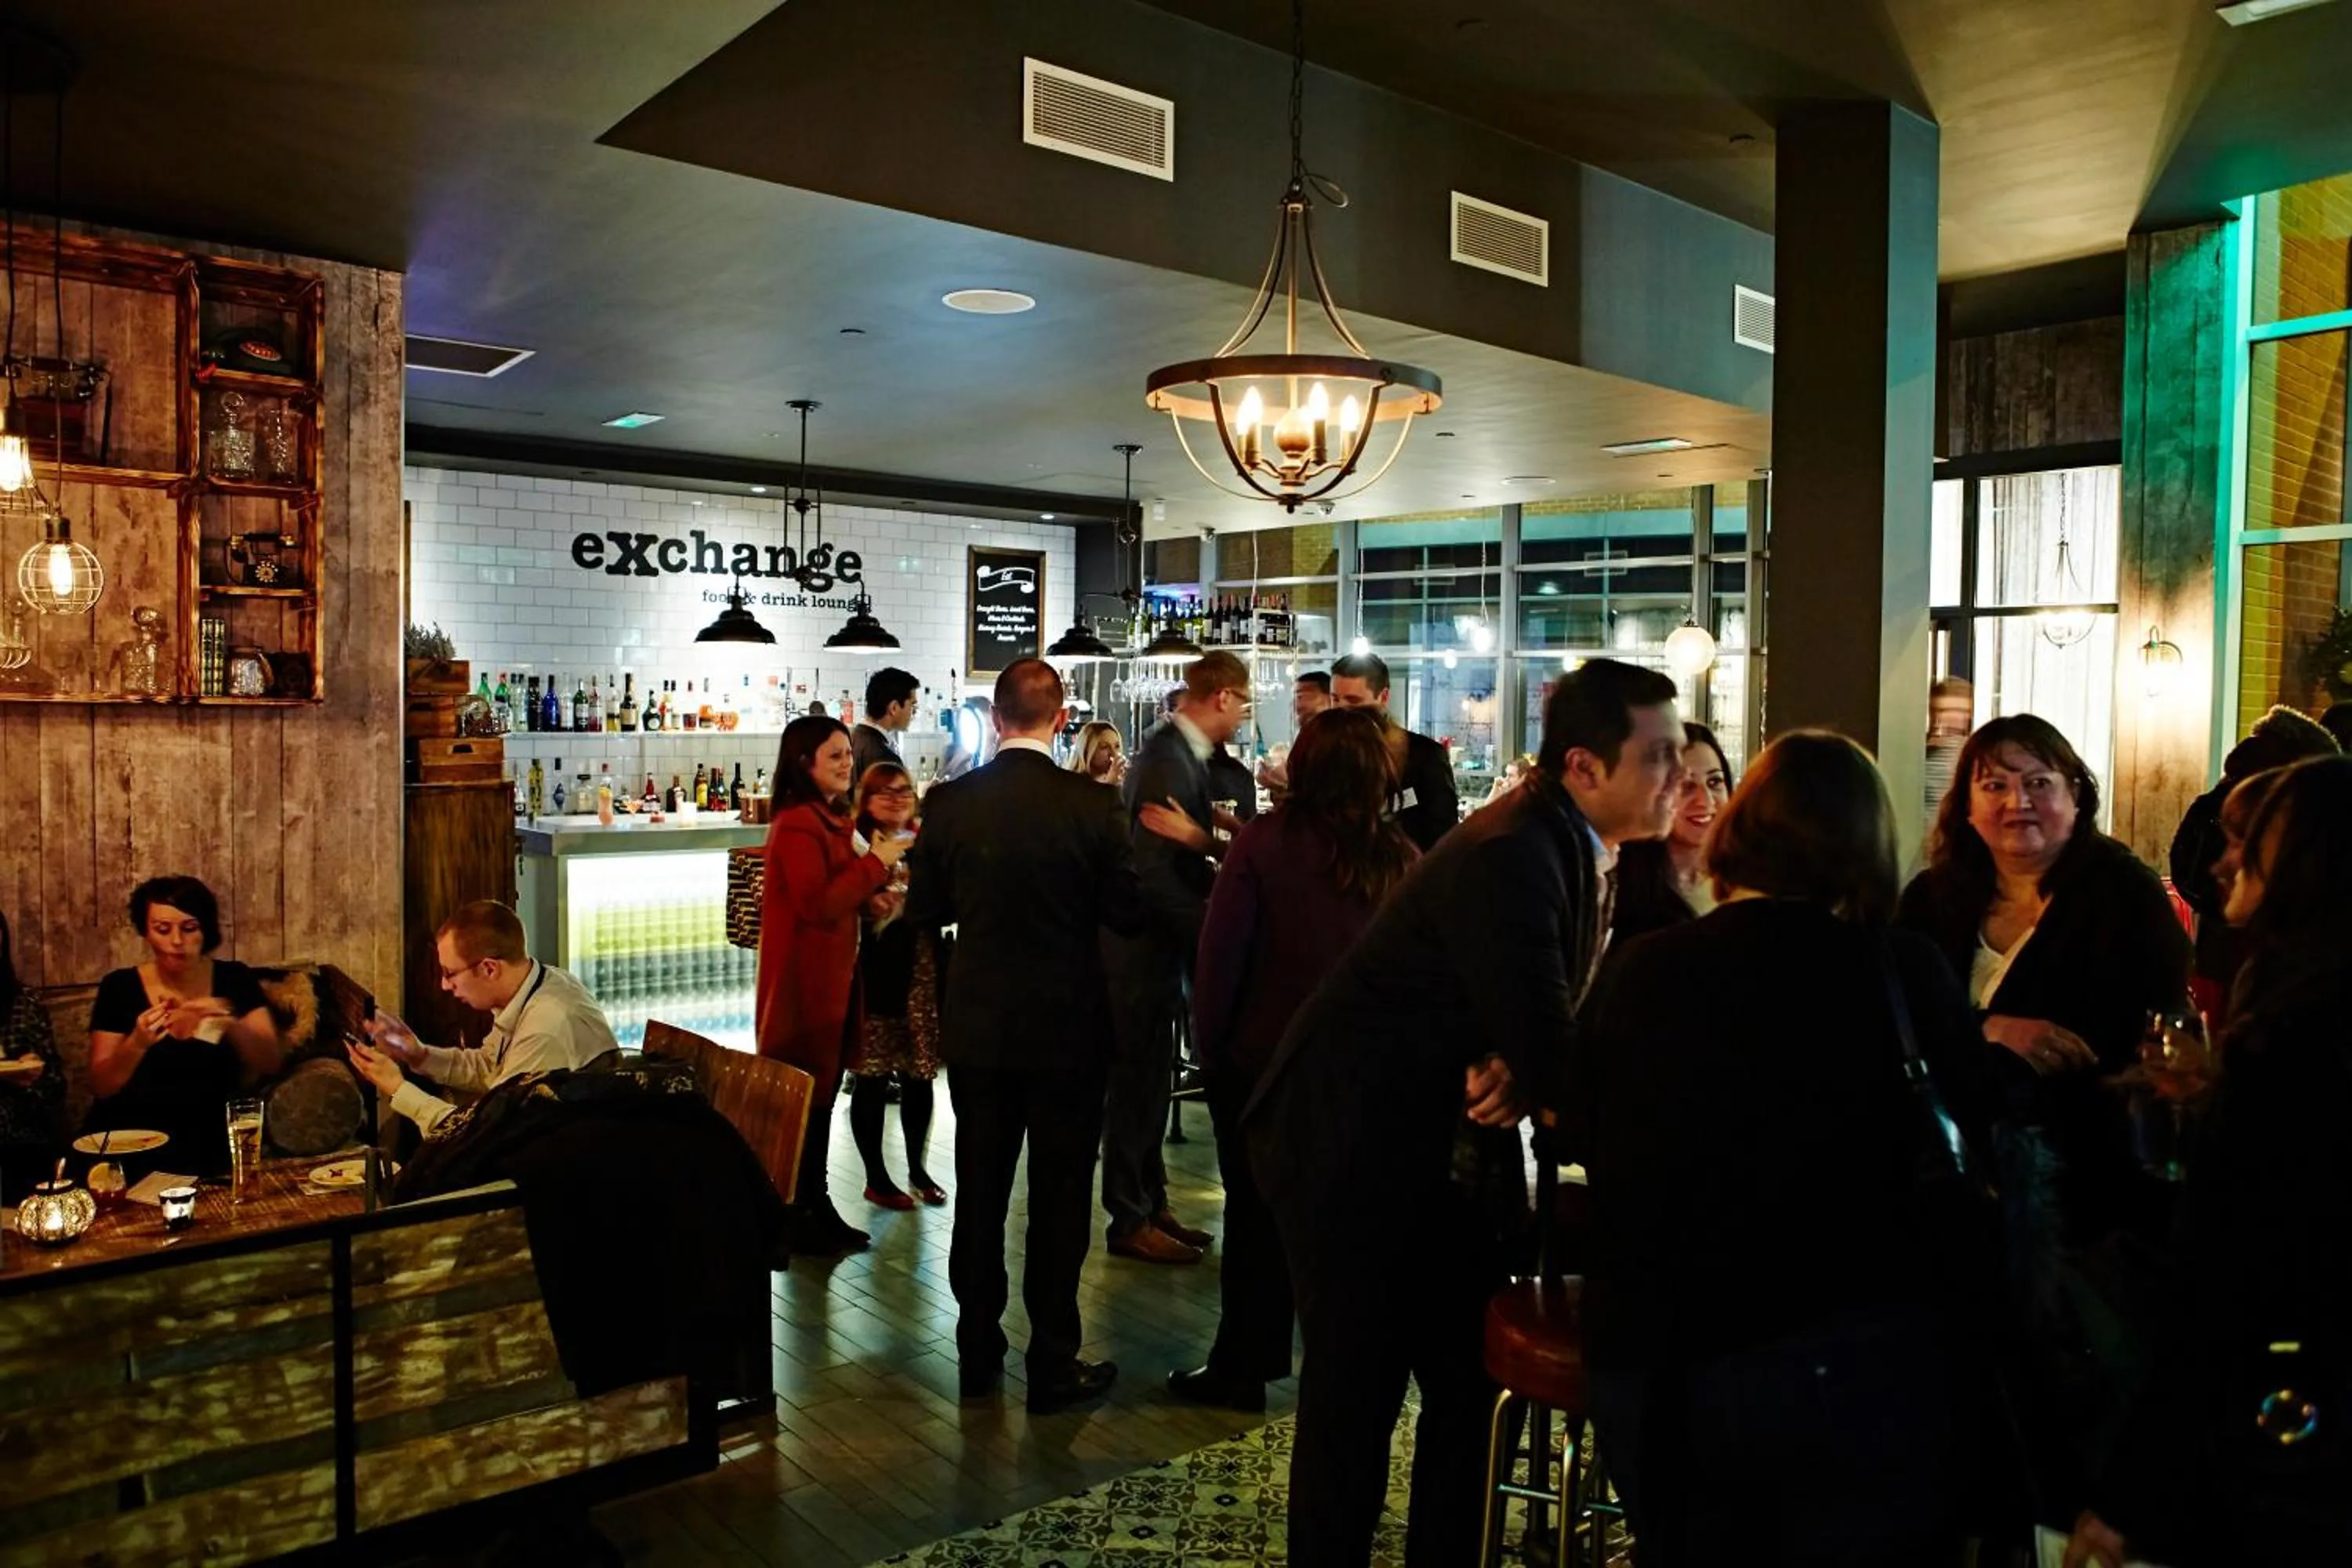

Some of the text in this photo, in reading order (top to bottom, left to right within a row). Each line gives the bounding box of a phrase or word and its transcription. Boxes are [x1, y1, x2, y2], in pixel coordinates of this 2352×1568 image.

[572, 530, 862, 593] exchange
[702, 590, 729, 604] foo
[761, 592, 808, 607] drink
[812, 595, 860, 612] loung
